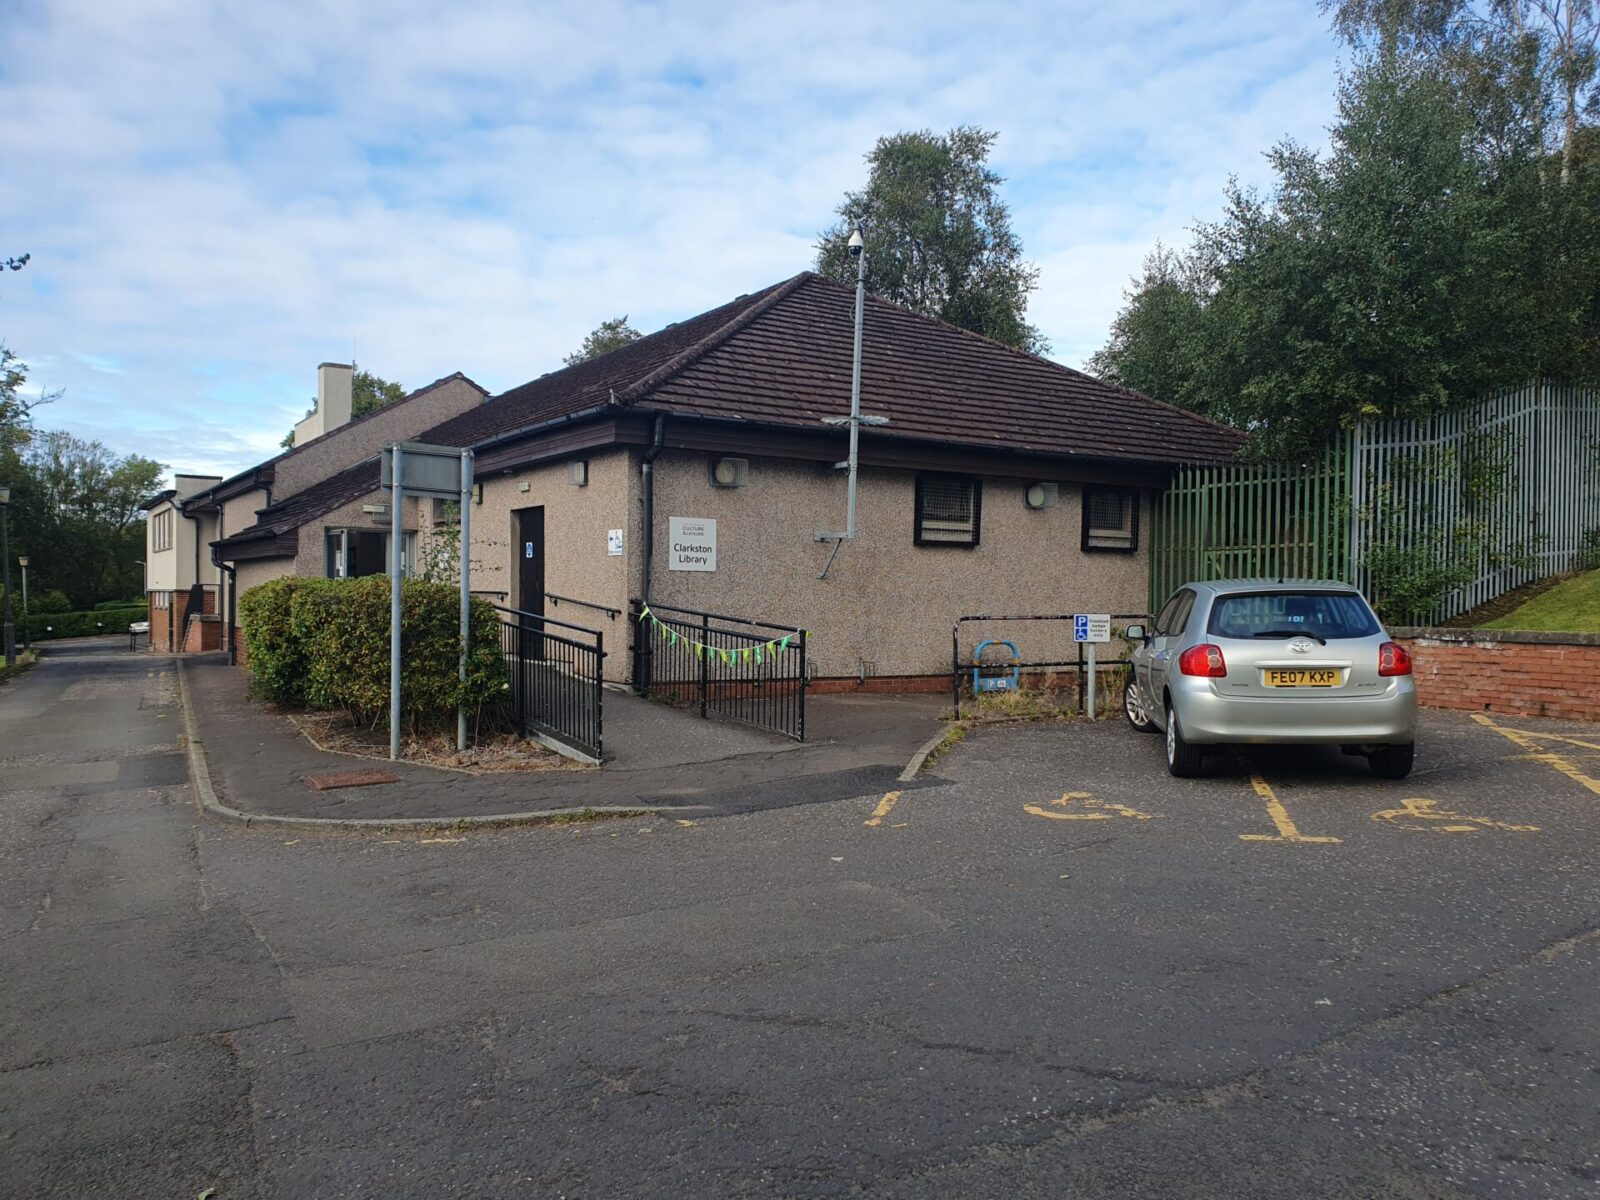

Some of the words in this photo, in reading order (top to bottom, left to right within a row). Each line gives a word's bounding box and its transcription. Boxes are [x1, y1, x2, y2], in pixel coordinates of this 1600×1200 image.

[673, 543, 712, 553] Clarkston
[679, 554, 707, 566] Library
[1078, 617, 1086, 627] P
[1271, 672, 1305, 683] FE07
[1309, 672, 1334, 683] KXP
